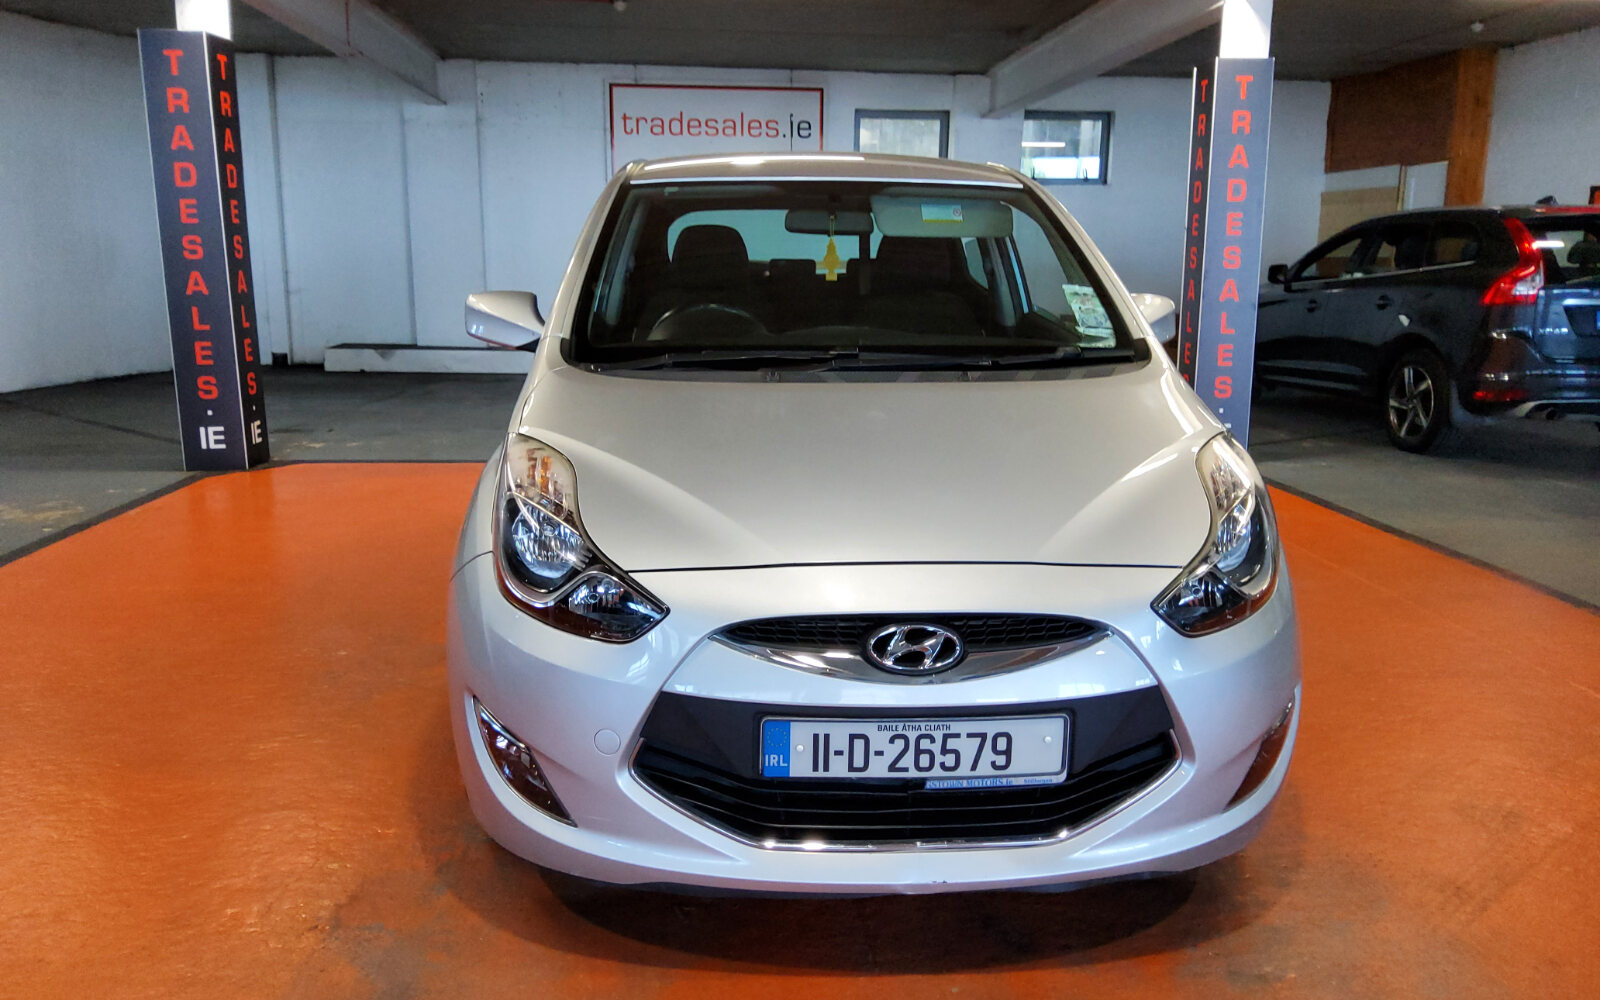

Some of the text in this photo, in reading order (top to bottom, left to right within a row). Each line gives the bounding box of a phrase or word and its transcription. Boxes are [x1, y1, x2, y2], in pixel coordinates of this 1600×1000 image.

[621, 110, 812, 139] tradesales.ie
[163, 49, 226, 450] TRADESALES.IE
[217, 54, 263, 445] TRADESALES.IE
[877, 724, 900, 732] BAILE
[924, 723, 951, 732] CLIATH
[765, 754, 788, 767] IRL
[812, 731, 1013, 773] 11-D-26579
